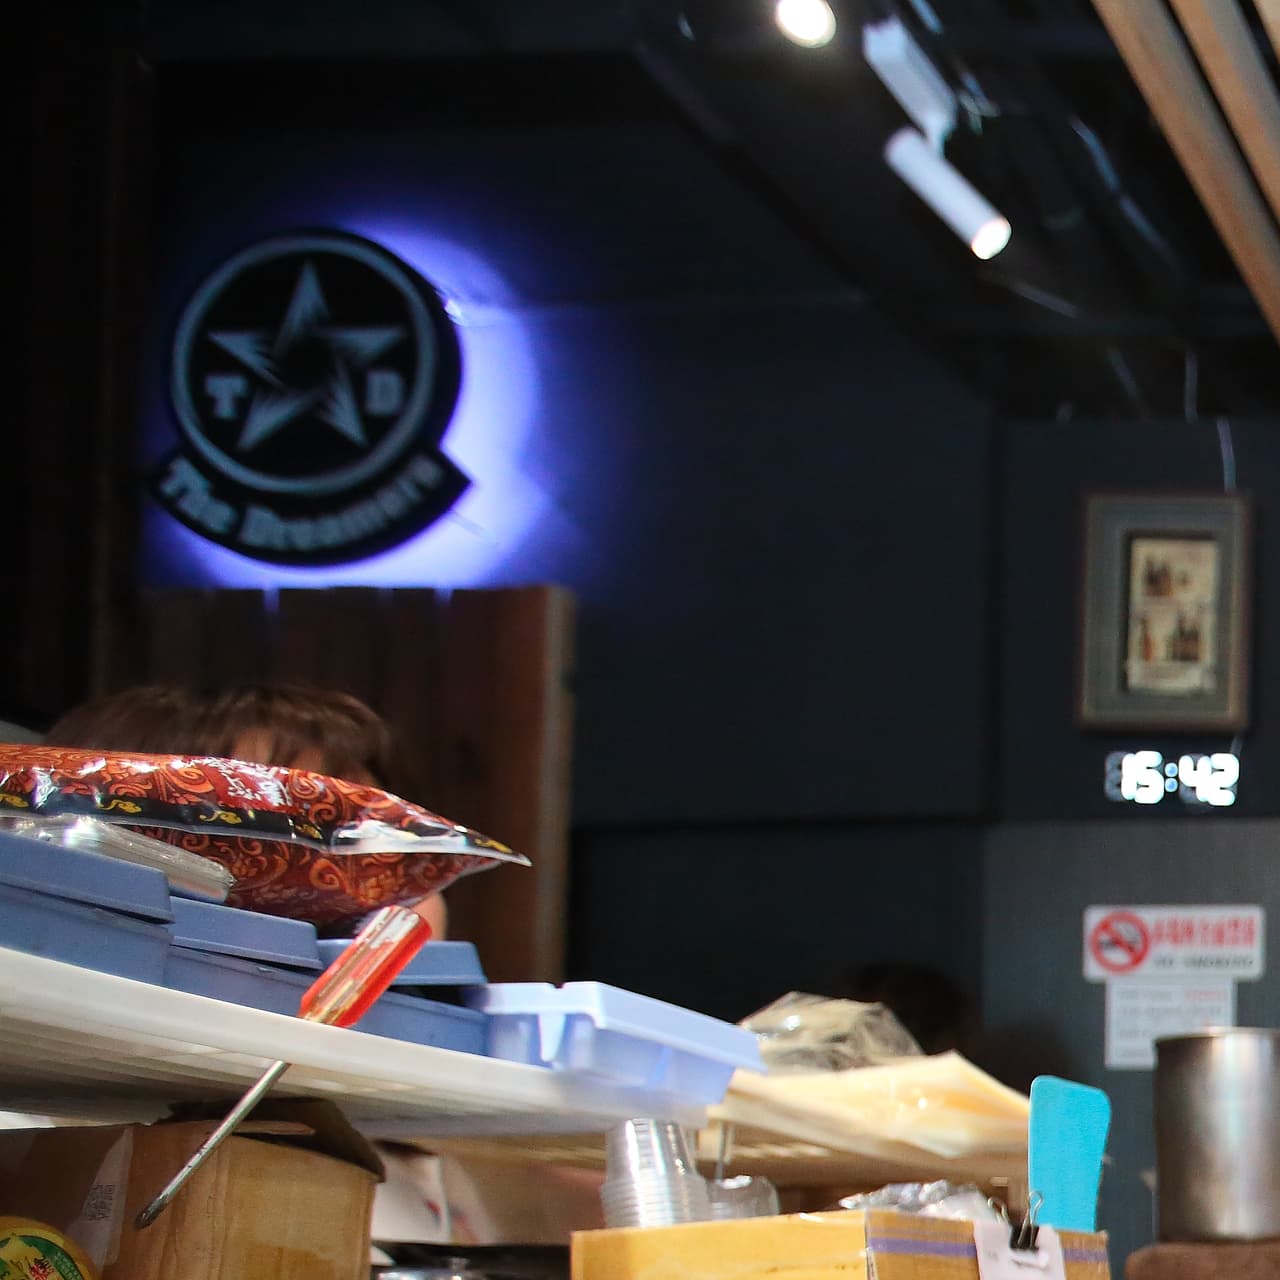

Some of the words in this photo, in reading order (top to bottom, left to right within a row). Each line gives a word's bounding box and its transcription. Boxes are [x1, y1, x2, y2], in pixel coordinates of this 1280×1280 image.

[205, 375, 249, 419] T
[162, 458, 235, 532] The
[1121, 750, 1240, 806] 15:42
